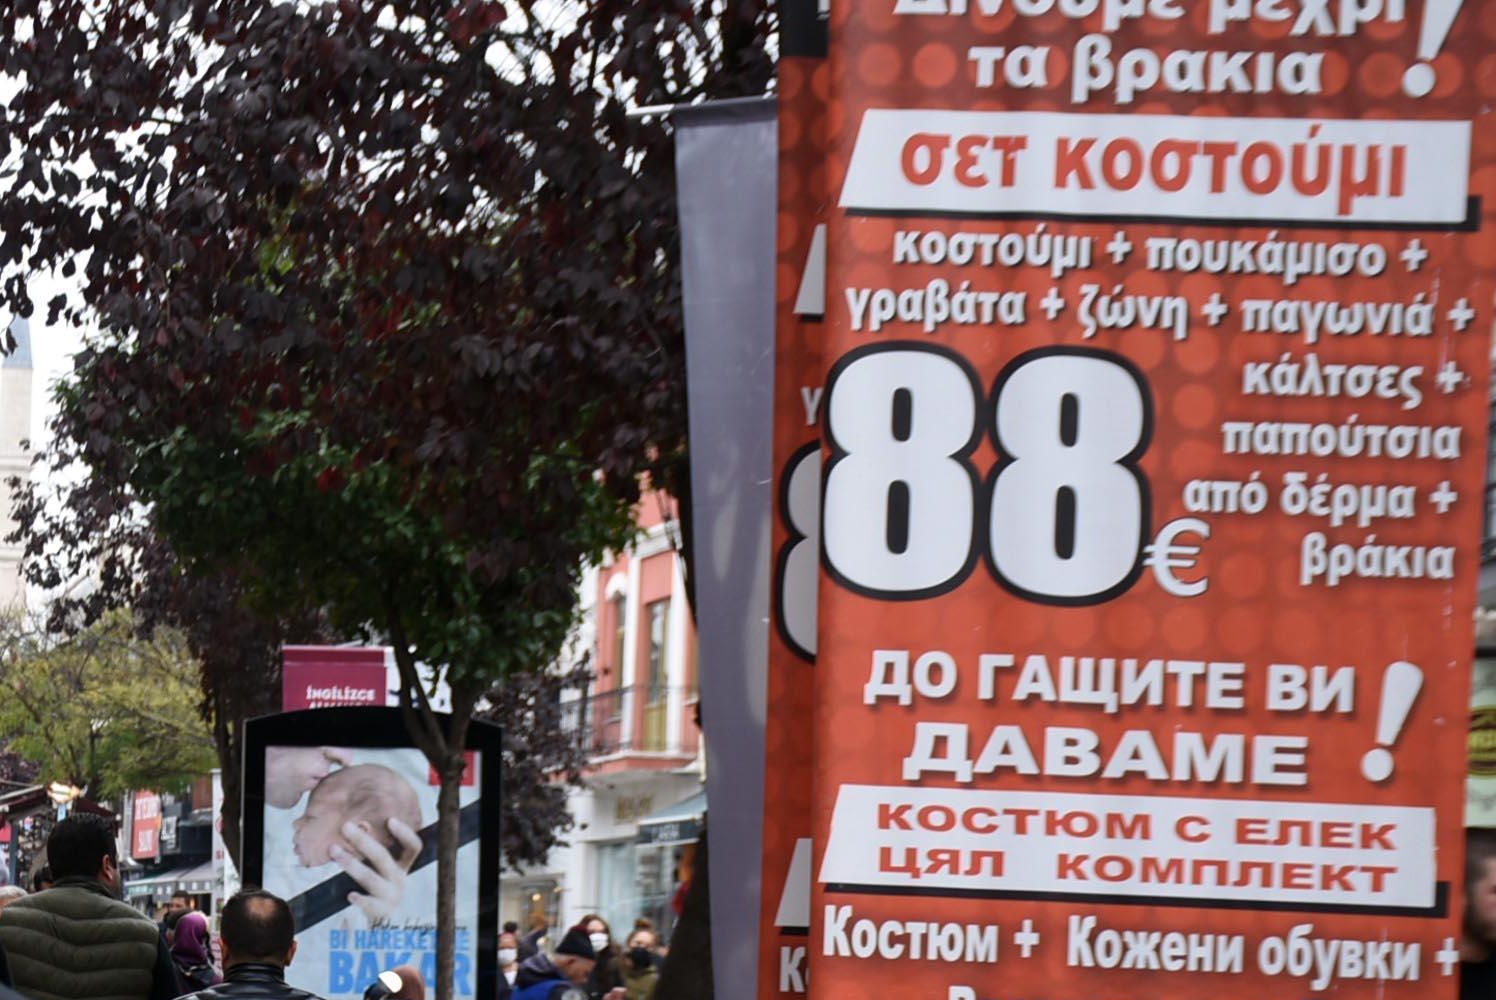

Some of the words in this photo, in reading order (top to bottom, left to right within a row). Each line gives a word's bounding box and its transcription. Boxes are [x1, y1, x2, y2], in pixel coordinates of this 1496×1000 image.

[967, 45, 1050, 87] τα
[1071, 33, 1324, 103] βρακια
[900, 133, 1028, 188] σετ
[1054, 124, 1406, 216] κοστούμι
[893, 222, 1091, 278] κοστούμι
[1145, 230, 1386, 285] πουκάμισο
[845, 278, 1026, 333] γραβάτα
[1077, 283, 1188, 340] ζώνη
[1241, 292, 1434, 344] παγωνιά
[1243, 352, 1423, 409] κάλτσες
[1222, 414, 1461, 459] παπούτσια
[1183, 471, 1267, 514] από
[1281, 472, 1416, 528] δέρμα
[1301, 532, 1455, 586] βράκια
[863, 649, 957, 706] ДО
[978, 654, 1246, 713] ГАЩИТЕ
[1266, 664, 1355, 713] ВИ
[902, 721, 1308, 785] ДАВАМЕ
[877, 803, 1152, 840] КОСТЮМ
[1175, 815, 1210, 843] С
[1235, 818, 1395, 850] ЕЛЕК
[879, 846, 1005, 879] ЦЯЛ
[1057, 852, 1397, 893] КОМПЛЕКТ
[823, 904, 998, 963] Костюм
[1067, 914, 1244, 973] Кожени
[1259, 923, 1420, 991] обувки
